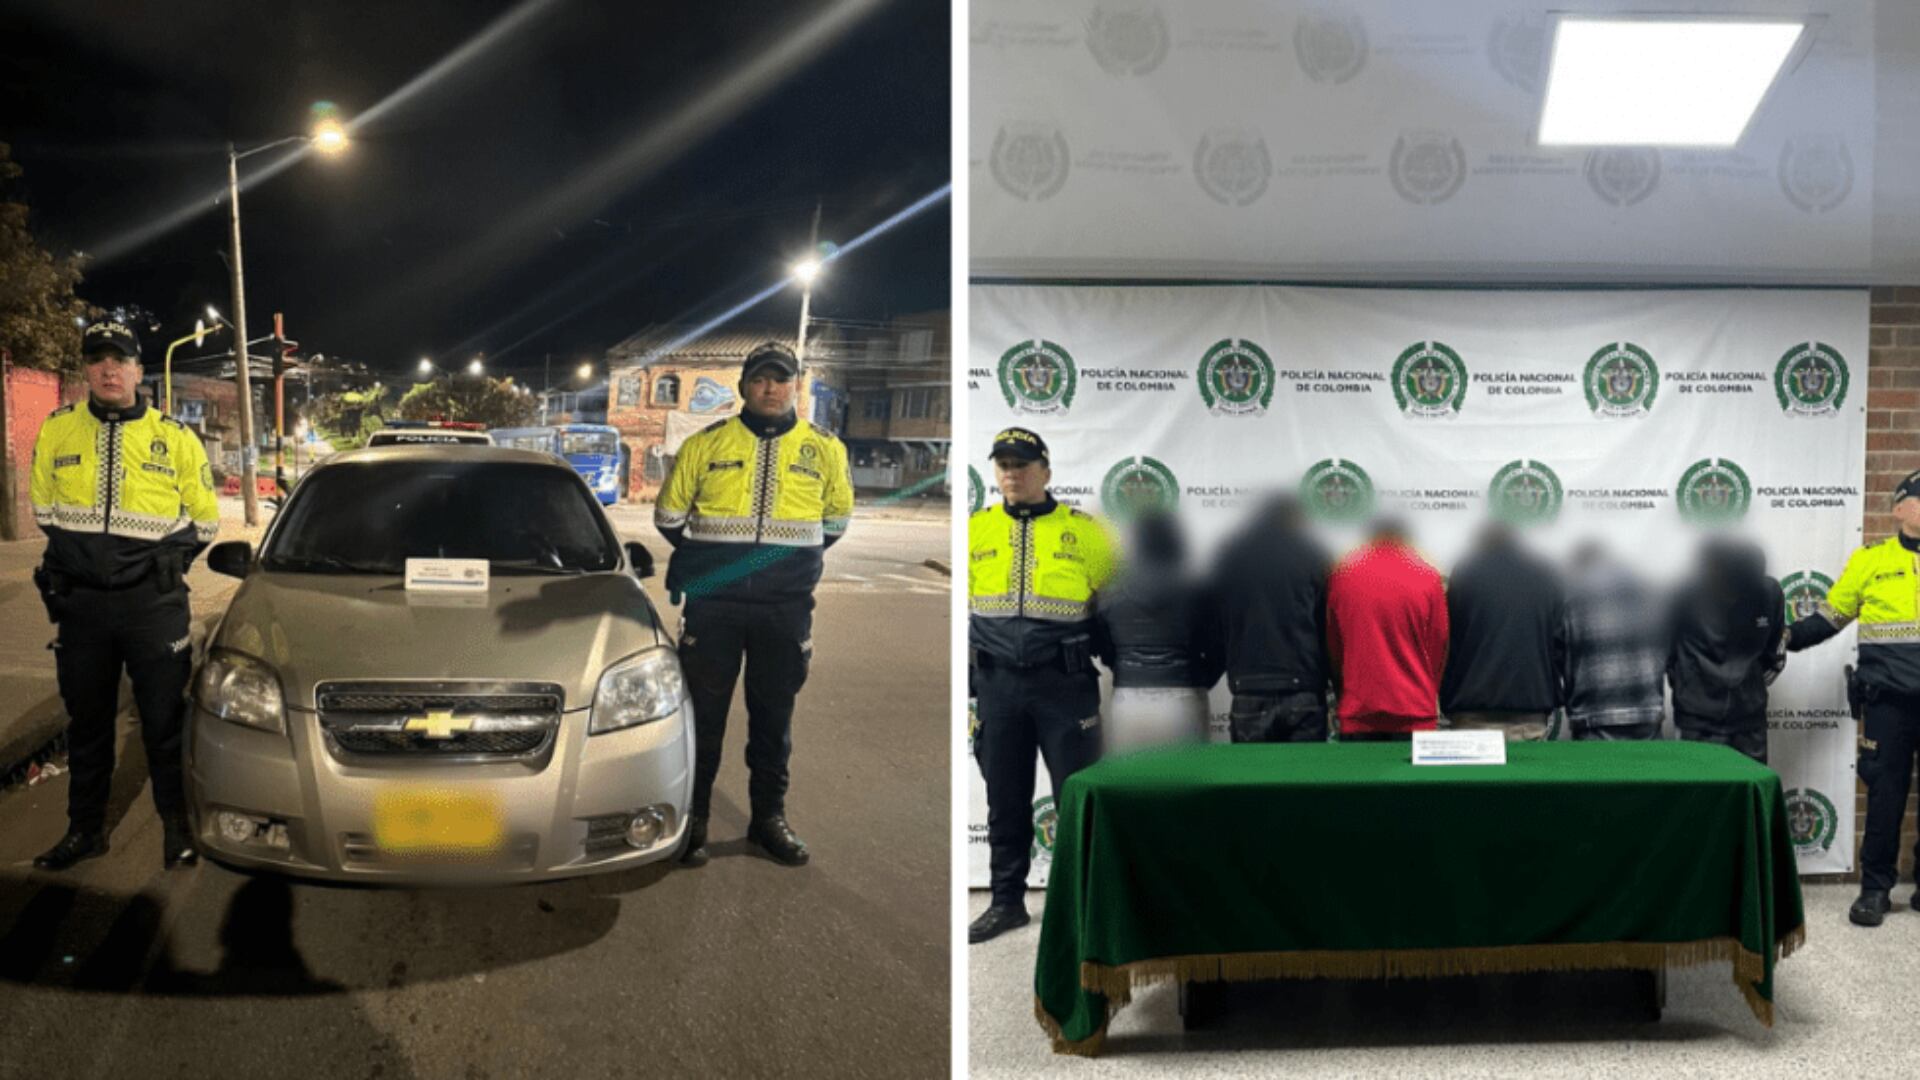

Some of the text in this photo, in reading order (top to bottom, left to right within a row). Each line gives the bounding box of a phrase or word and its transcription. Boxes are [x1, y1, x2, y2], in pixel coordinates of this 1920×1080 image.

[1081, 367, 1189, 379] POLICÍA NACIONAL
[1281, 367, 1386, 381] POLICÍA NACIONAL
[1473, 370, 1577, 383] POLICÍA NACIONAL
[1665, 369, 1767, 381] POLICÍA NACIONAL
[1097, 381, 1175, 391] DE COLOMBIA
[1296, 383, 1372, 392] DE COLOMBIA
[1487, 385, 1563, 395] DE COLOMBIA
[1679, 384, 1753, 393] DE COLOMBIA
[1045, 485, 1095, 495] ACIONAL
[1186, 484, 1231, 496] POLICÍA
[1424, 489, 1482, 499] NACIONAL
[1612, 488, 1669, 498] NACIONAL
[1803, 486, 1859, 496] NACIONAL
[1410, 501, 1468, 511] COLOMBIA
[1599, 500, 1656, 510] COLOMBIA
[1771, 498, 1845, 508] DE COLOMBIA
[1767, 708, 1795, 719] LICÍA
[1782, 721, 1839, 730] COLOMBIA
